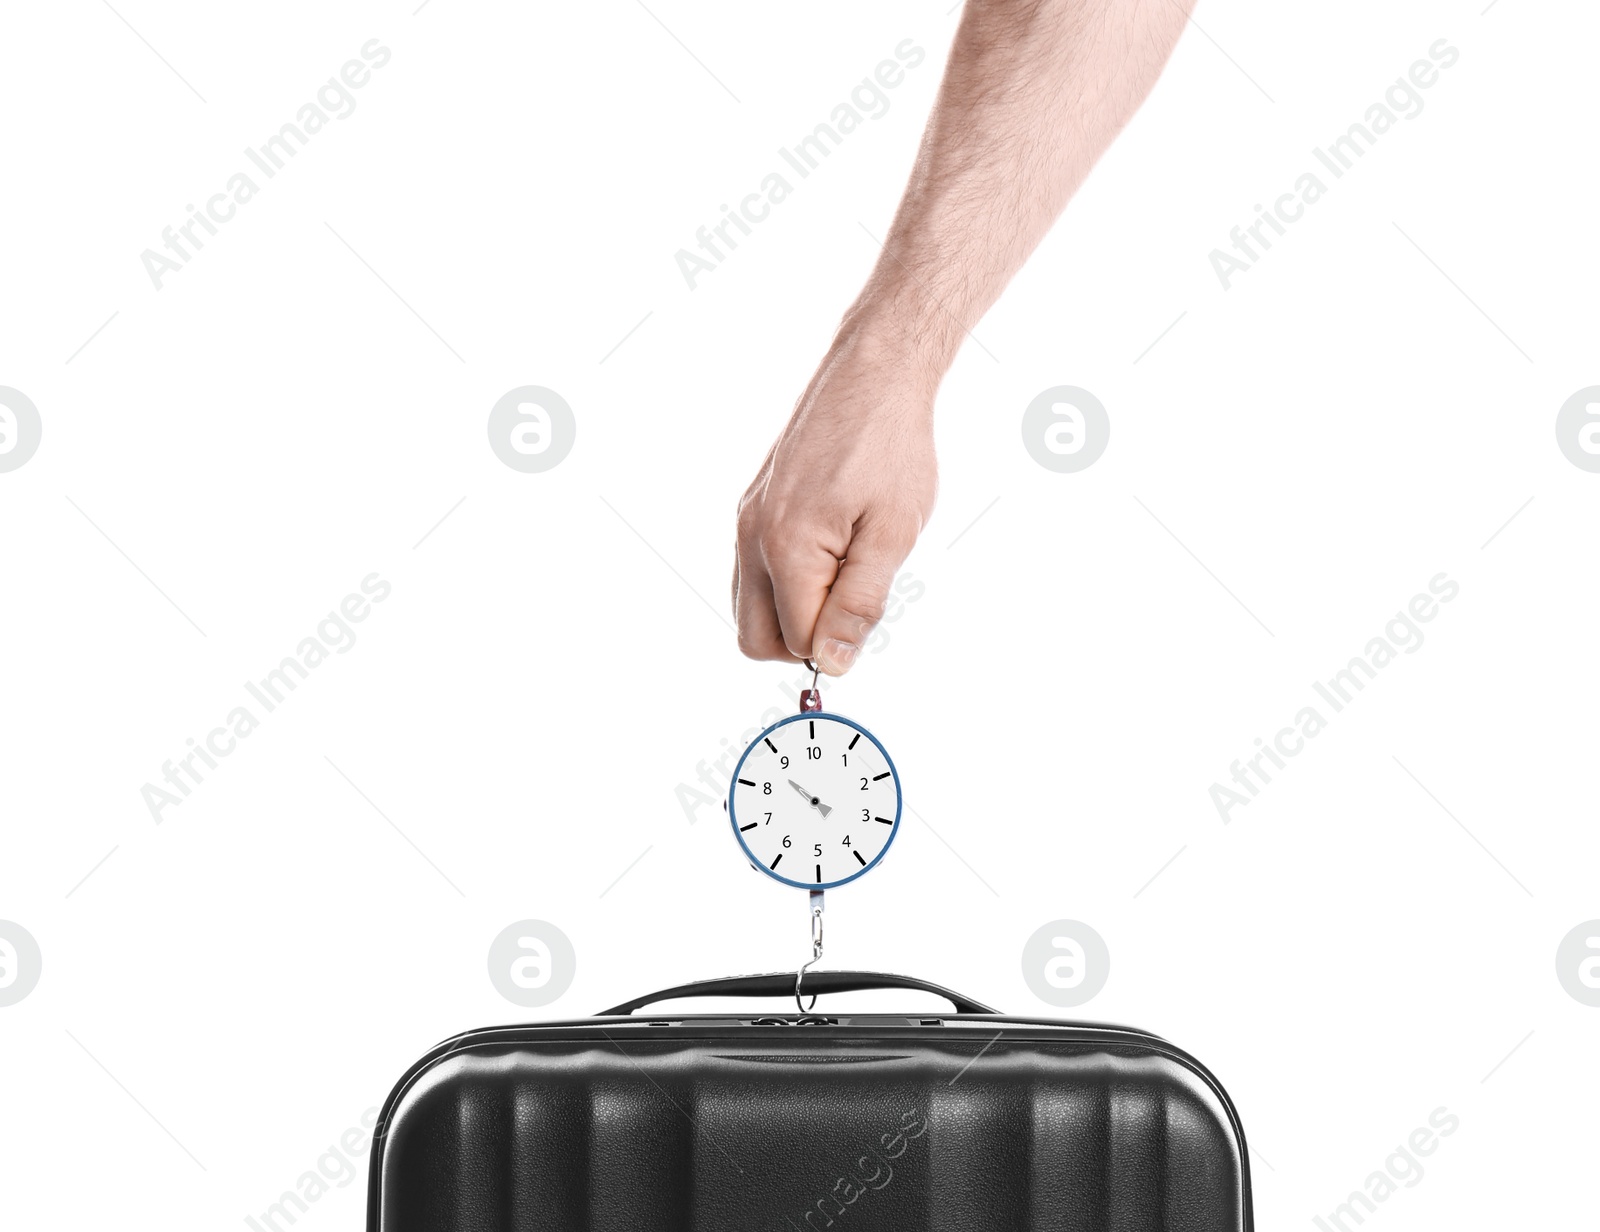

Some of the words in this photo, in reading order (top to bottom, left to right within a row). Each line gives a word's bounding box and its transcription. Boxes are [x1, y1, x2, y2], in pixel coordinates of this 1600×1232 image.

[806, 746, 822, 760] 10
[841, 753, 847, 767] 1
[780, 755, 790, 770] 9
[763, 781, 773, 796] 8
[860, 777, 869, 791] 2
[764, 812, 773, 826] 7
[861, 808, 871, 823] 3
[782, 834, 792, 849] 6
[841, 834, 852, 848] 4
[813, 843, 823, 857] 5
